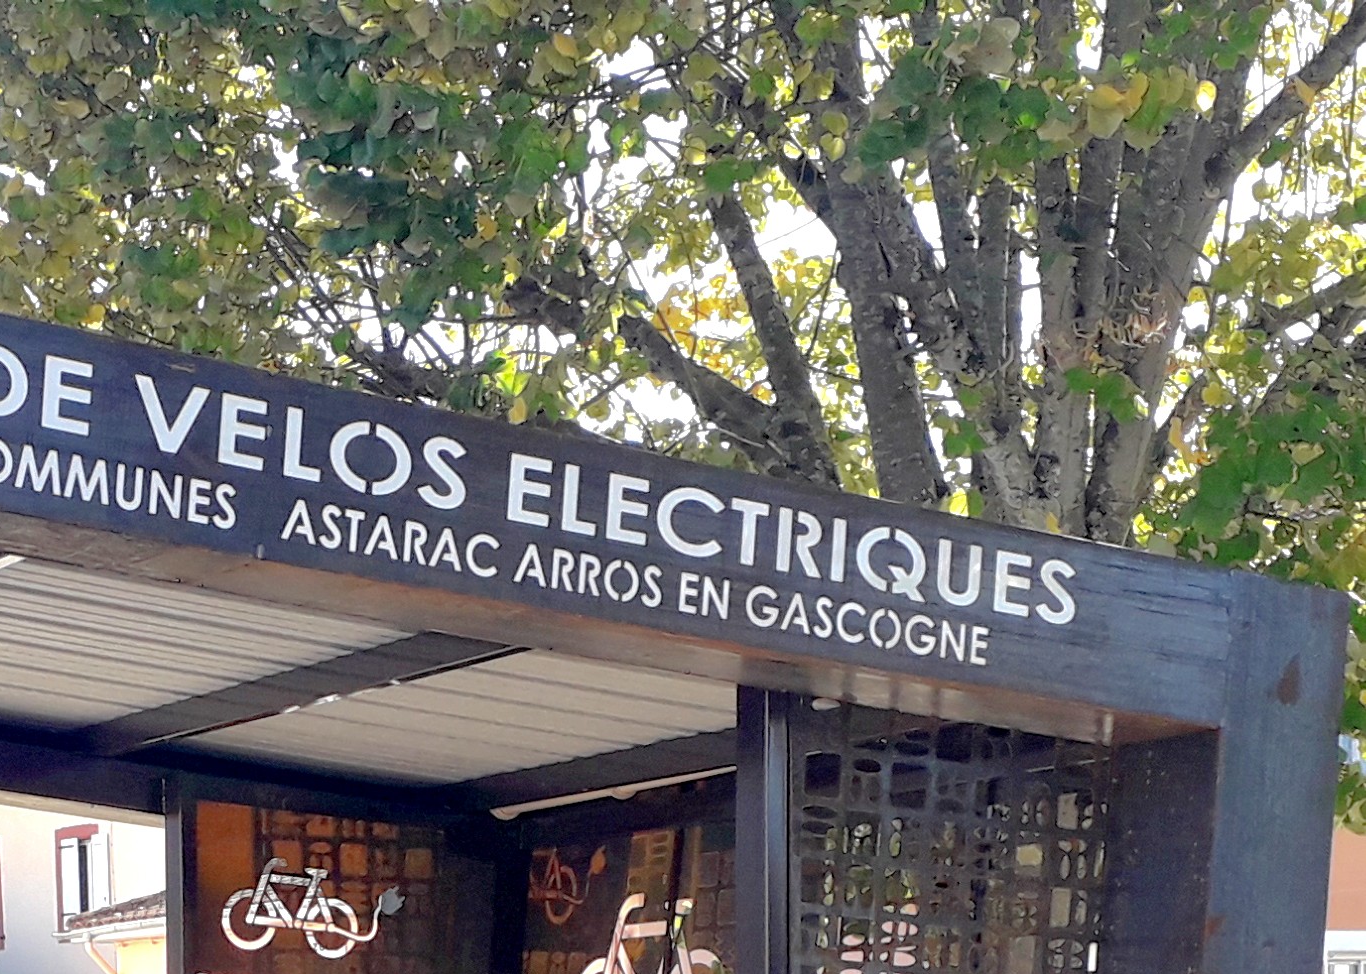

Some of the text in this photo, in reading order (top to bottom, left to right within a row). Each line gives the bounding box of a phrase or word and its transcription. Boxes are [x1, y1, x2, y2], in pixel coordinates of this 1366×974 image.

[134, 373, 468, 511] VELOS
[506, 452, 1078, 626] ELECTRIQUES
[280, 499, 501, 578] ASTARAC
[512, 543, 663, 608] ARROS
[677, 572, 731, 621] EN
[744, 584, 991, 667] GASCOGNE
